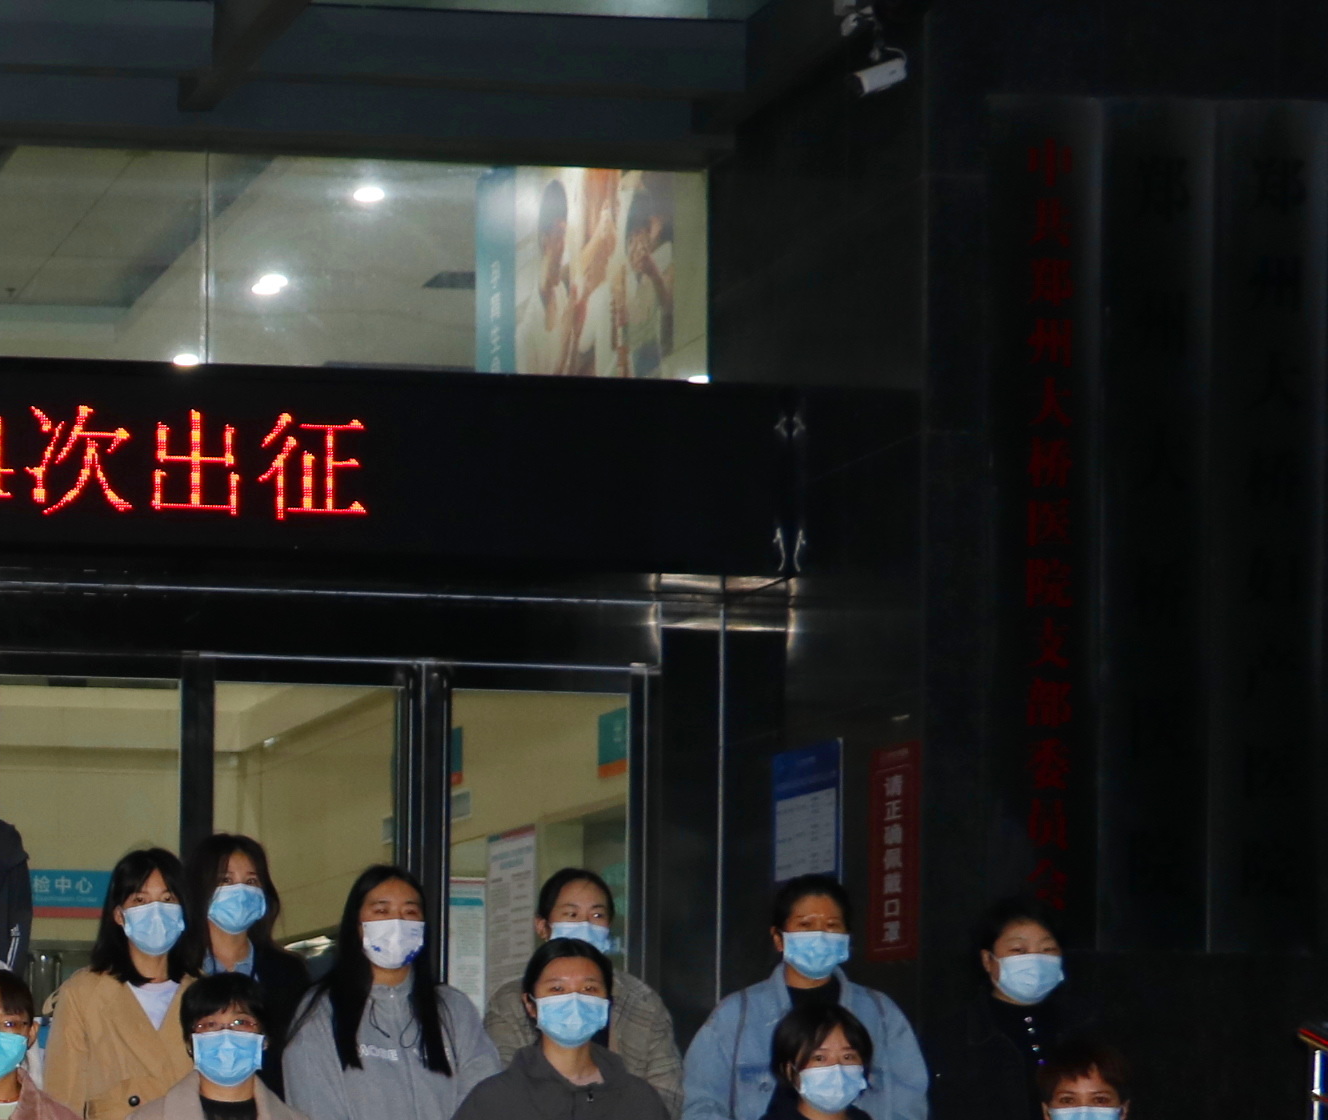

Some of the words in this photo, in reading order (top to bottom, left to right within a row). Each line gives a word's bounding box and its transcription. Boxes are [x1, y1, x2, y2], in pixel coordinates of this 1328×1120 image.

[1024, 137, 1074, 910] 中共郑州大桥医院支部委员会
